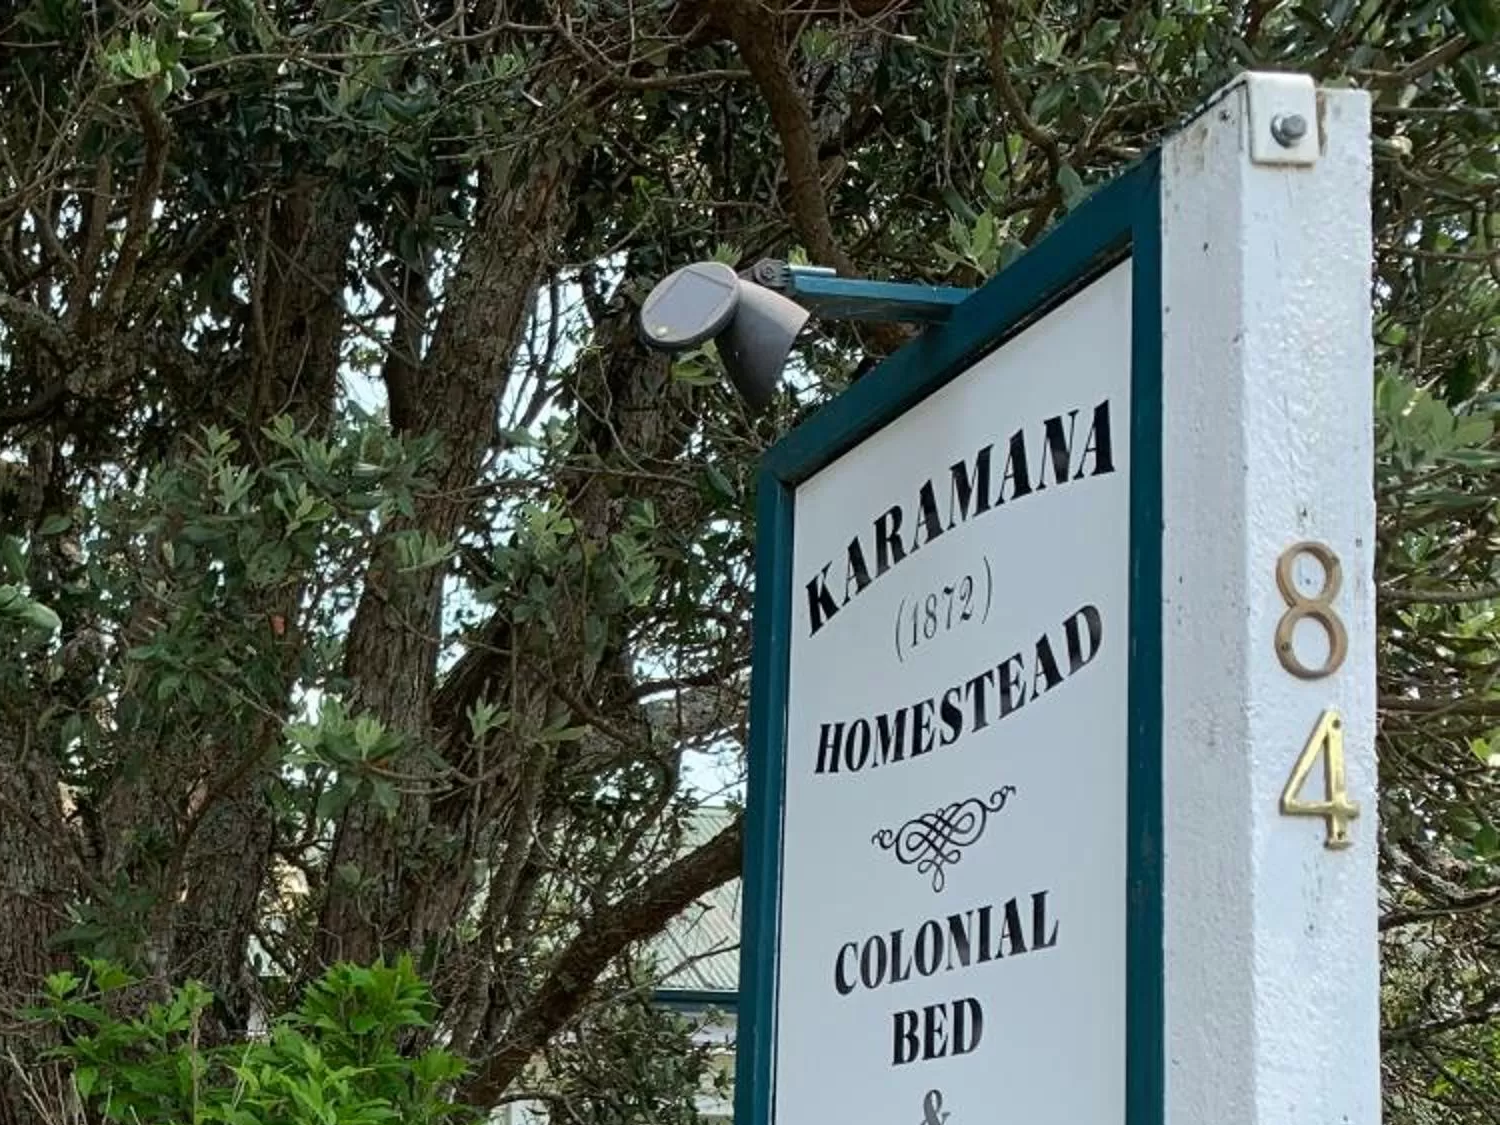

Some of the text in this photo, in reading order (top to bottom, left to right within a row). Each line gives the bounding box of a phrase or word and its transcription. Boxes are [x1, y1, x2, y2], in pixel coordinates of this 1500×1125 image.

[804, 399, 1116, 638] KARAMANA
[894, 555, 993, 664] (1872)
[813, 604, 1103, 774] HOMESTEAD
[833, 890, 1060, 997] COLONIAL
[890, 996, 984, 1066] BED
